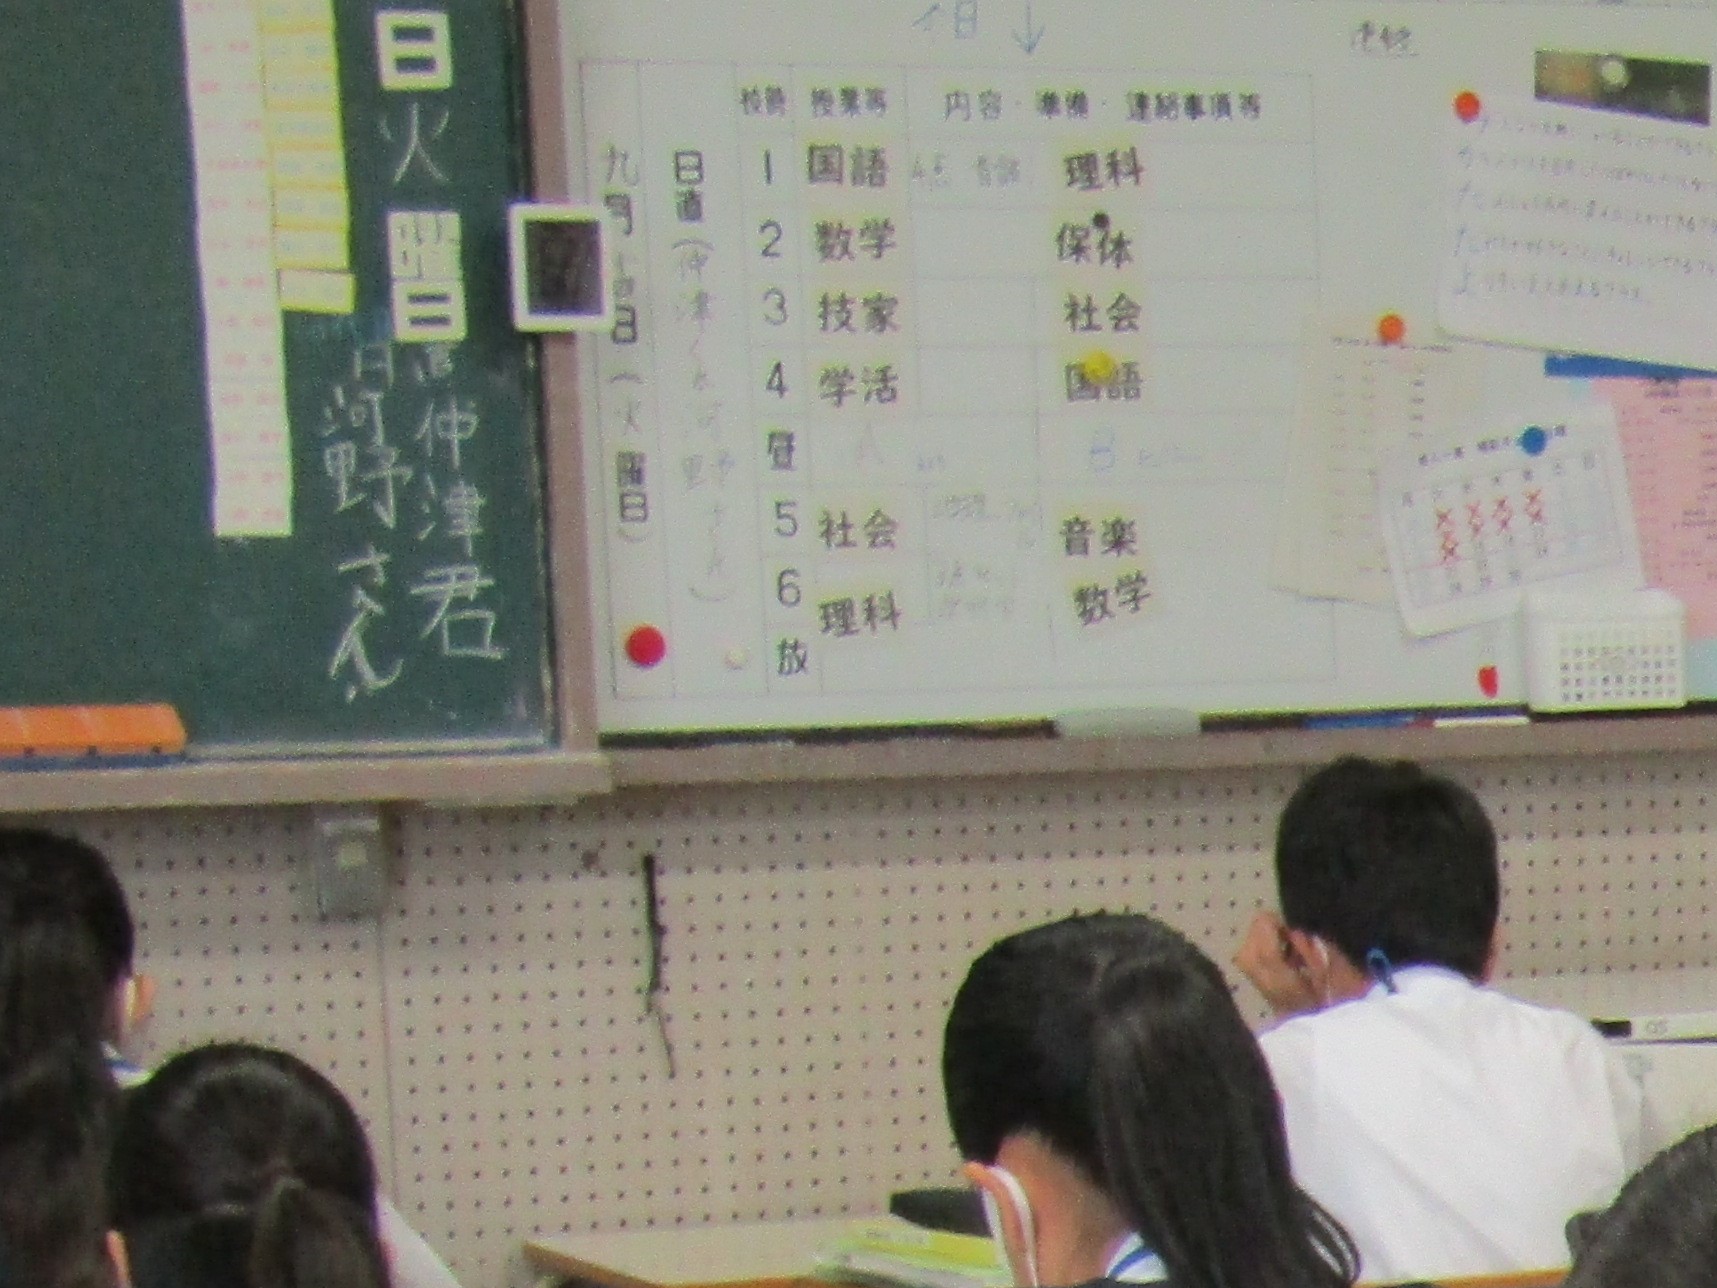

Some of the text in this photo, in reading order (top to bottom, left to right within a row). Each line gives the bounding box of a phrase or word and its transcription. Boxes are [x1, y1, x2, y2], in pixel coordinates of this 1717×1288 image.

[762, 149, 774, 185] 1
[806, 143, 890, 189] 国語
[1062, 144, 1145, 191] 理科
[758, 218, 783, 258] 2
[814, 218, 898, 263] 数学
[762, 287, 1142, 336] 3 技家 社会
[765, 361, 788, 399] 4
[818, 365, 900, 407] 学活
[775, 500, 1138, 558] 5 社会 音楽
[776, 568, 1152, 638] 6 理科 数学
